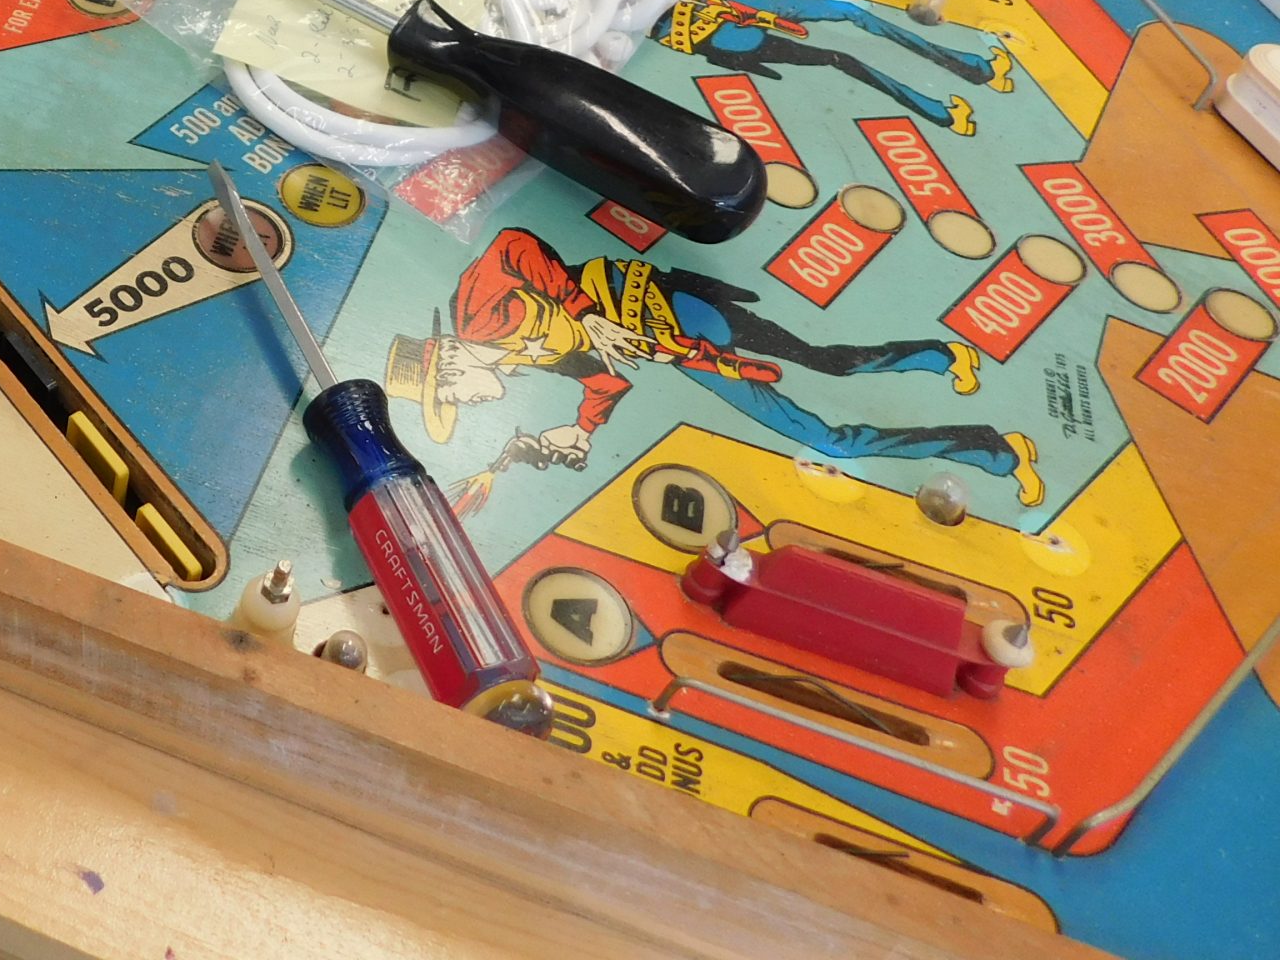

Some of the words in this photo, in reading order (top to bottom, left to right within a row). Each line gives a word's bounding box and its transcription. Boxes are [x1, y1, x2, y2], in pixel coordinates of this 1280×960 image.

[3, 8, 33, 35] FOR
[169, 107, 222, 145] 500
[212, 93, 243, 117] an
[227, 115, 266, 147] AD
[875, 129, 953, 198] 5000
[297, 173, 330, 213] WHEN
[326, 186, 352, 210] LIT
[1042, 176, 1126, 247] 3000
[793, 221, 865, 289] 6000
[1223, 227, 1280, 298] 000
[83, 255, 195, 327] 5000
[964, 271, 1046, 336] 4000
[1075, 364, 1090, 400] RESERVED
[1157, 329, 1239, 405] 2000
[1044, 378, 1059, 419] COPYRIGHT
[1079, 399, 1093, 426] RIGHTS
[1083, 428, 1096, 442] ALL
[661, 482, 706, 535] B
[375, 528, 444, 655] CRAFTSMAN
[1031, 586, 1077, 629] 50
[549, 597, 599, 648] A
[546, 693, 597, 754] 00
[601, 750, 633, 771] &
[635, 744, 669, 783] DD
[670, 742, 704, 796] NUS
[1002, 744, 1052, 798] 50
